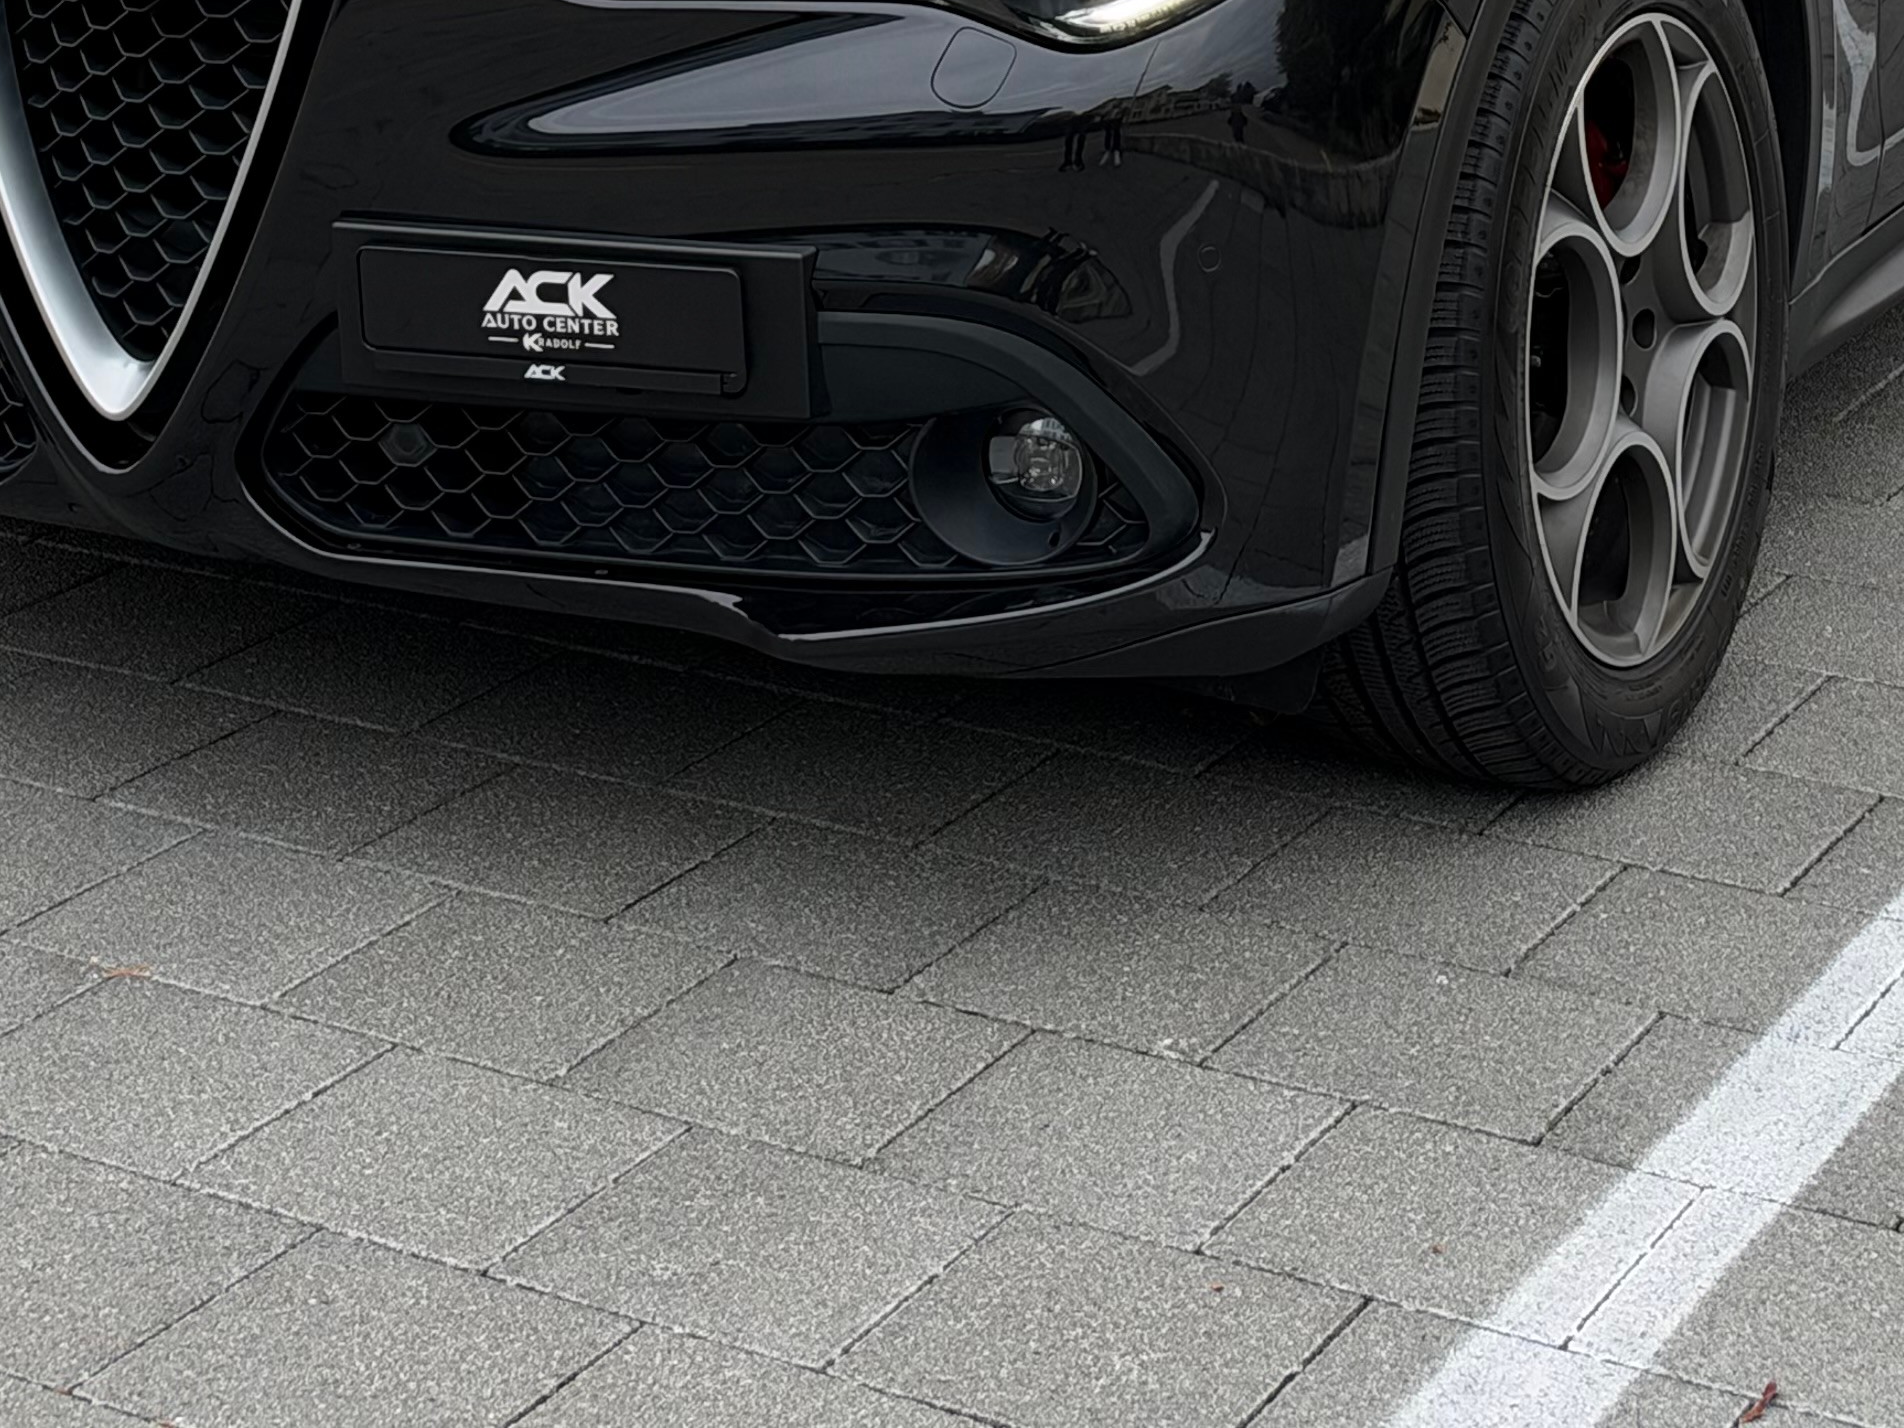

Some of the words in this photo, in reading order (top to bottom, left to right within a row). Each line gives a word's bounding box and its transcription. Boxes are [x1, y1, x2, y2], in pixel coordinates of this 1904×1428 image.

[482, 268, 617, 319] ACK
[481, 312, 537, 331] AUTO
[542, 316, 620, 337] CENTER
[524, 363, 566, 381] ACK
